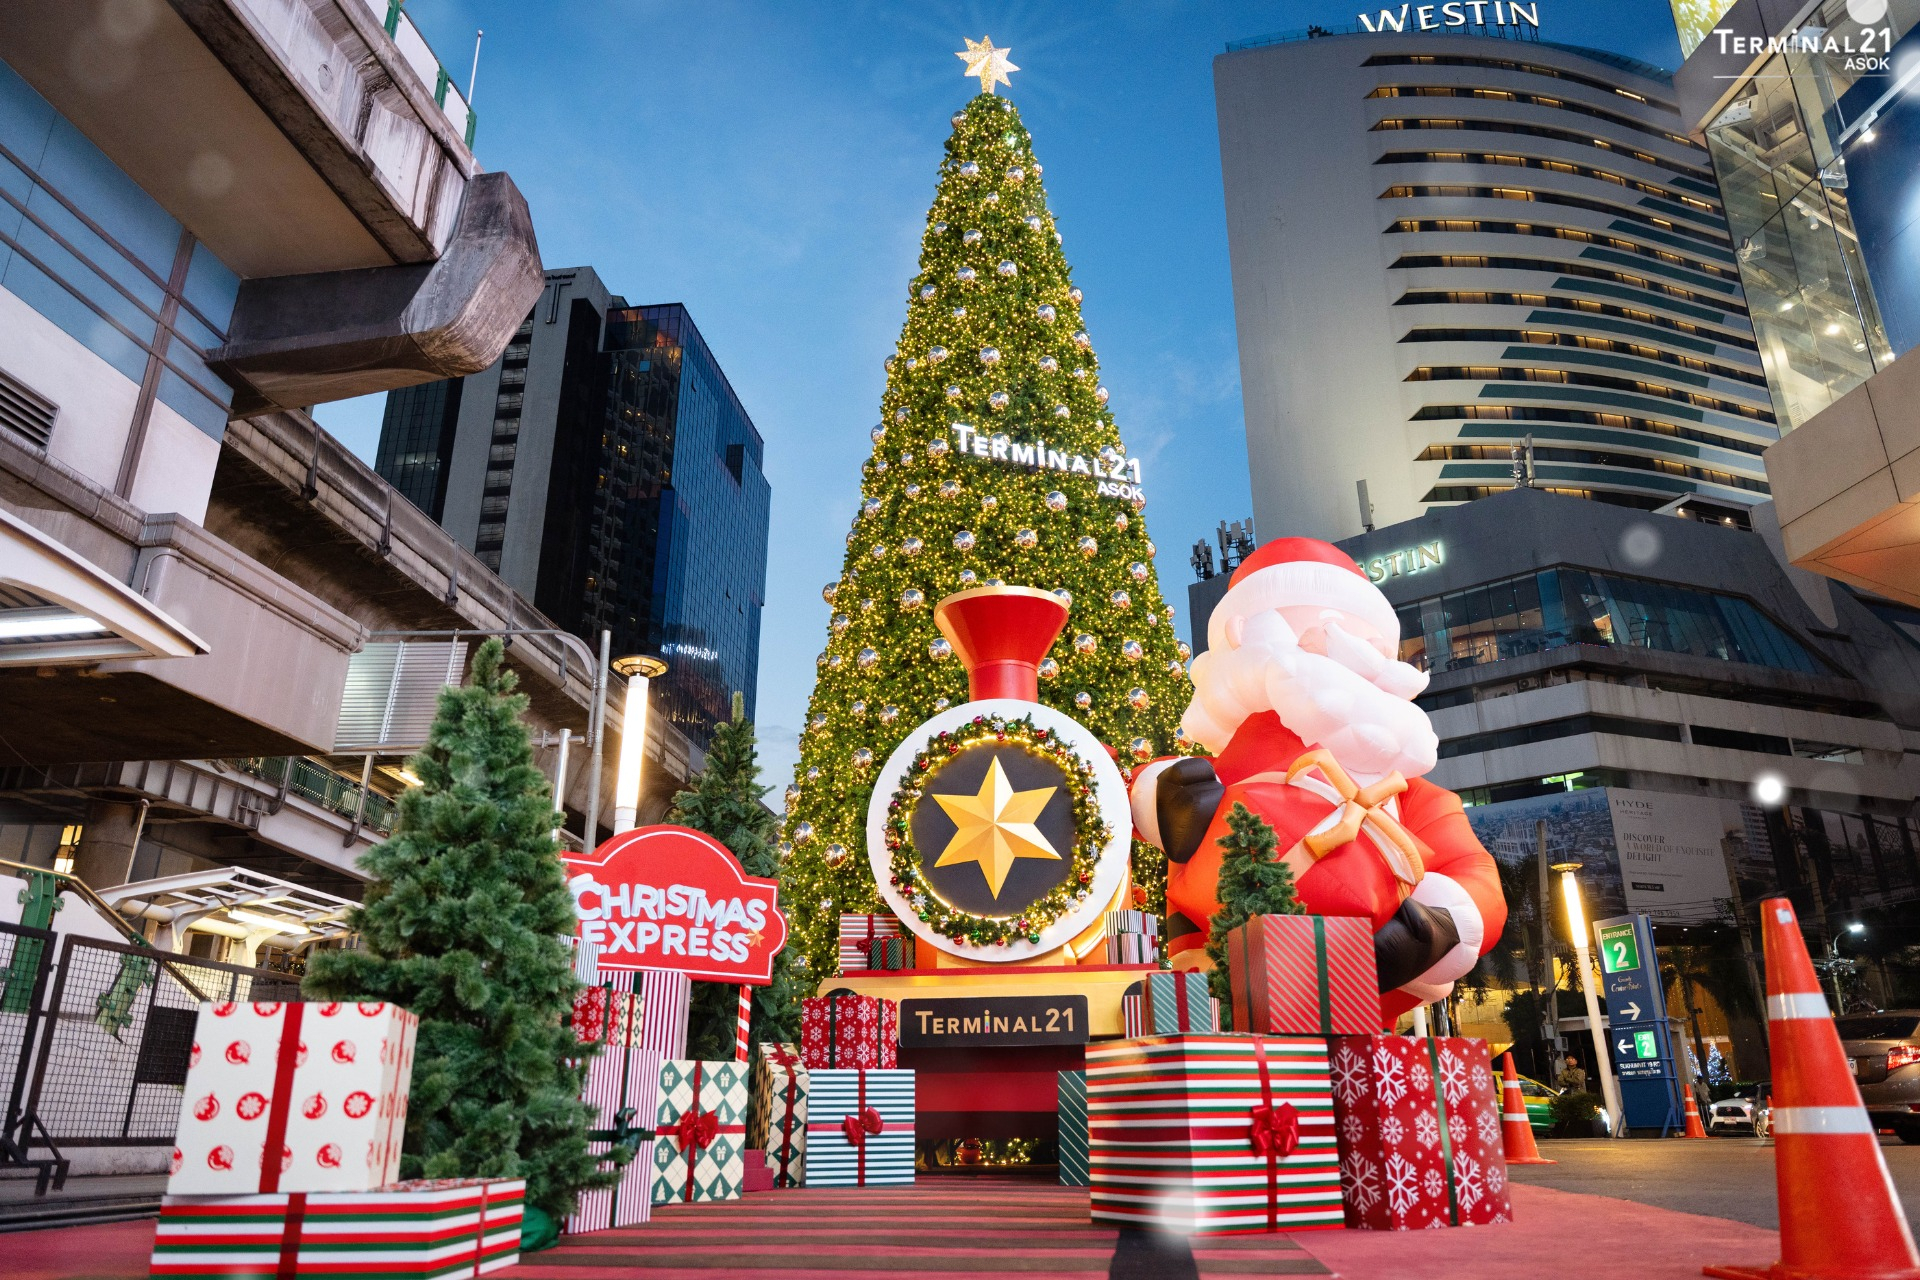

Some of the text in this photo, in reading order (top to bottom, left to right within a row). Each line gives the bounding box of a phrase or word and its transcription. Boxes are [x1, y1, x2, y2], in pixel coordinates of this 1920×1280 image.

[1358, 1, 1539, 33] WESTIN
[1097, 481, 1145, 500] ASOK
[1357, 541, 1441, 582] STIN
[1615, 799, 1654, 810] HYDE
[1623, 832, 1665, 844] DISCOVER
[1626, 851, 1662, 862] DELIGHT
[1633, 842, 1662, 854] WORLD
[1664, 845, 1674, 855] OF
[1675, 846, 1714, 857] EXQUISITE
[571, 879, 768, 931] CHRISTMAS
[582, 921, 750, 963] EXPRESS
[1602, 928, 1633, 941] ENTRANCE
[1613, 941, 1629, 969] 2
[1641, 1041, 1652, 1057] 2
